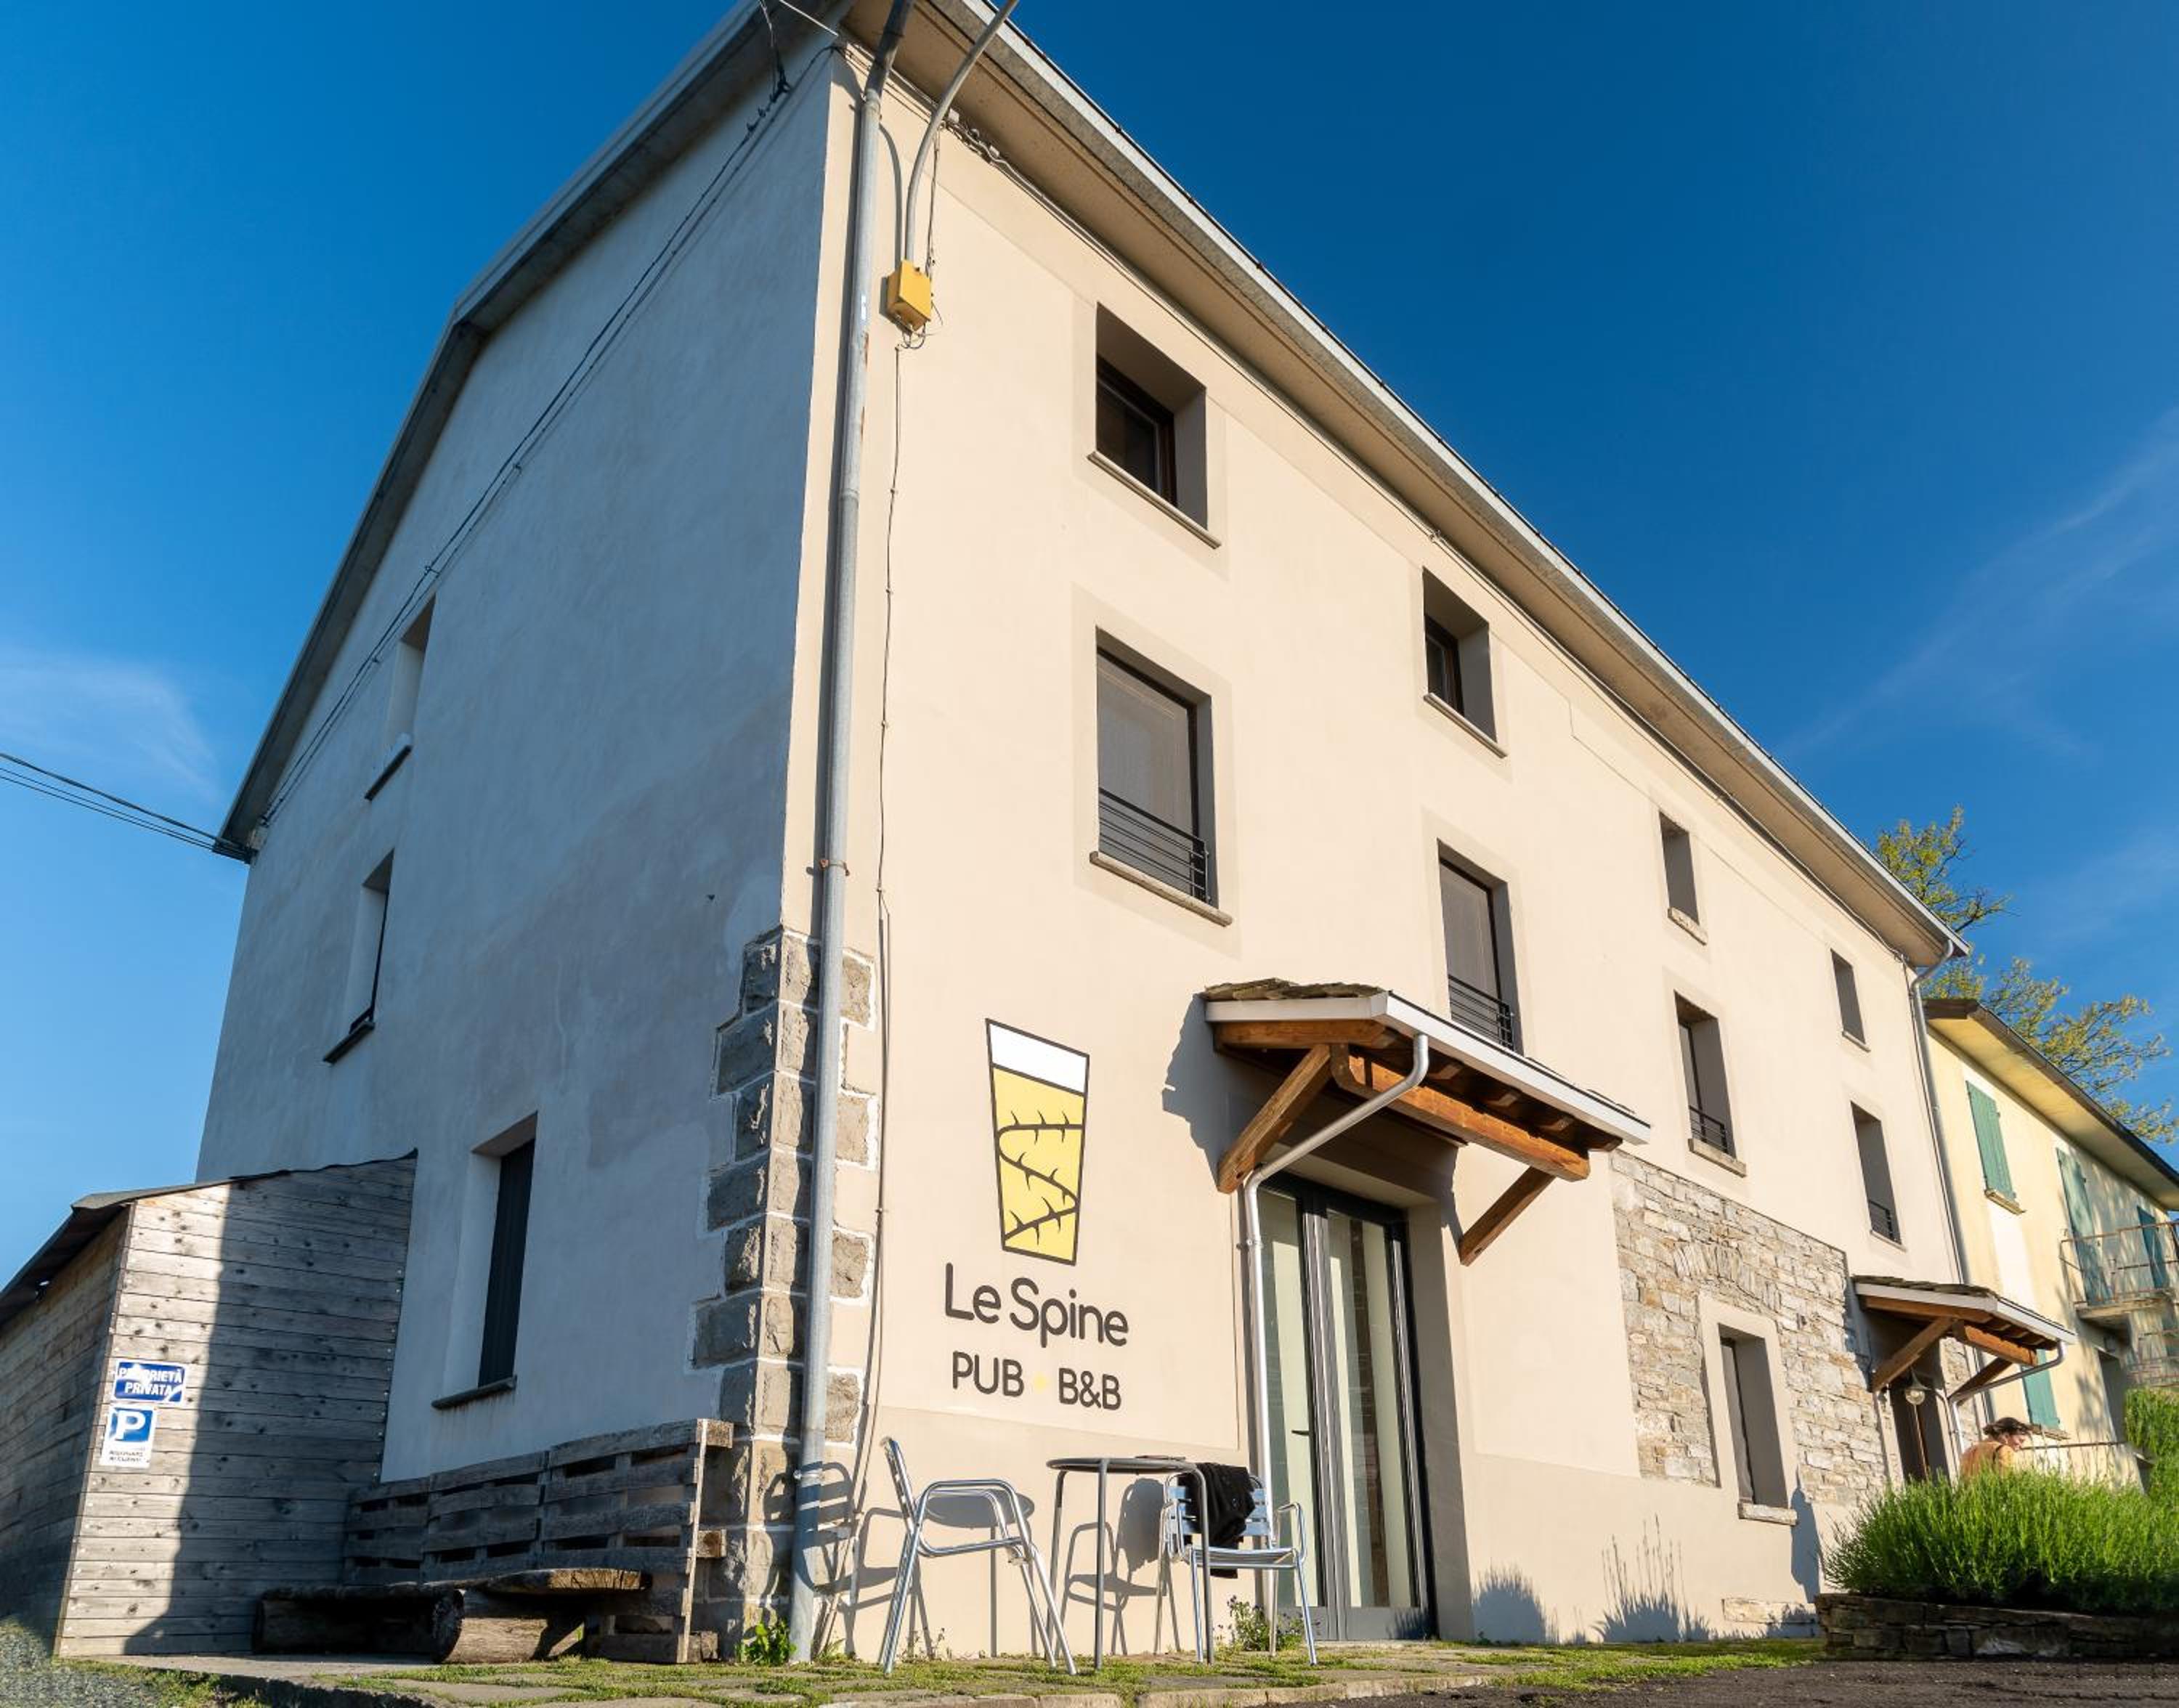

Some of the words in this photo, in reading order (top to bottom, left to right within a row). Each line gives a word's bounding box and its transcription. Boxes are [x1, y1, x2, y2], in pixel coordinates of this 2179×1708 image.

[945, 1262, 1002, 1324] Le
[1010, 1277, 1129, 1349] Spine
[118, 1367, 182, 1383] PRIETÀ
[124, 1381, 175, 1396] PRIVATA
[952, 1350, 1025, 1398] PUB
[1058, 1367, 1122, 1411] B&B
[115, 1410, 146, 1440] P
